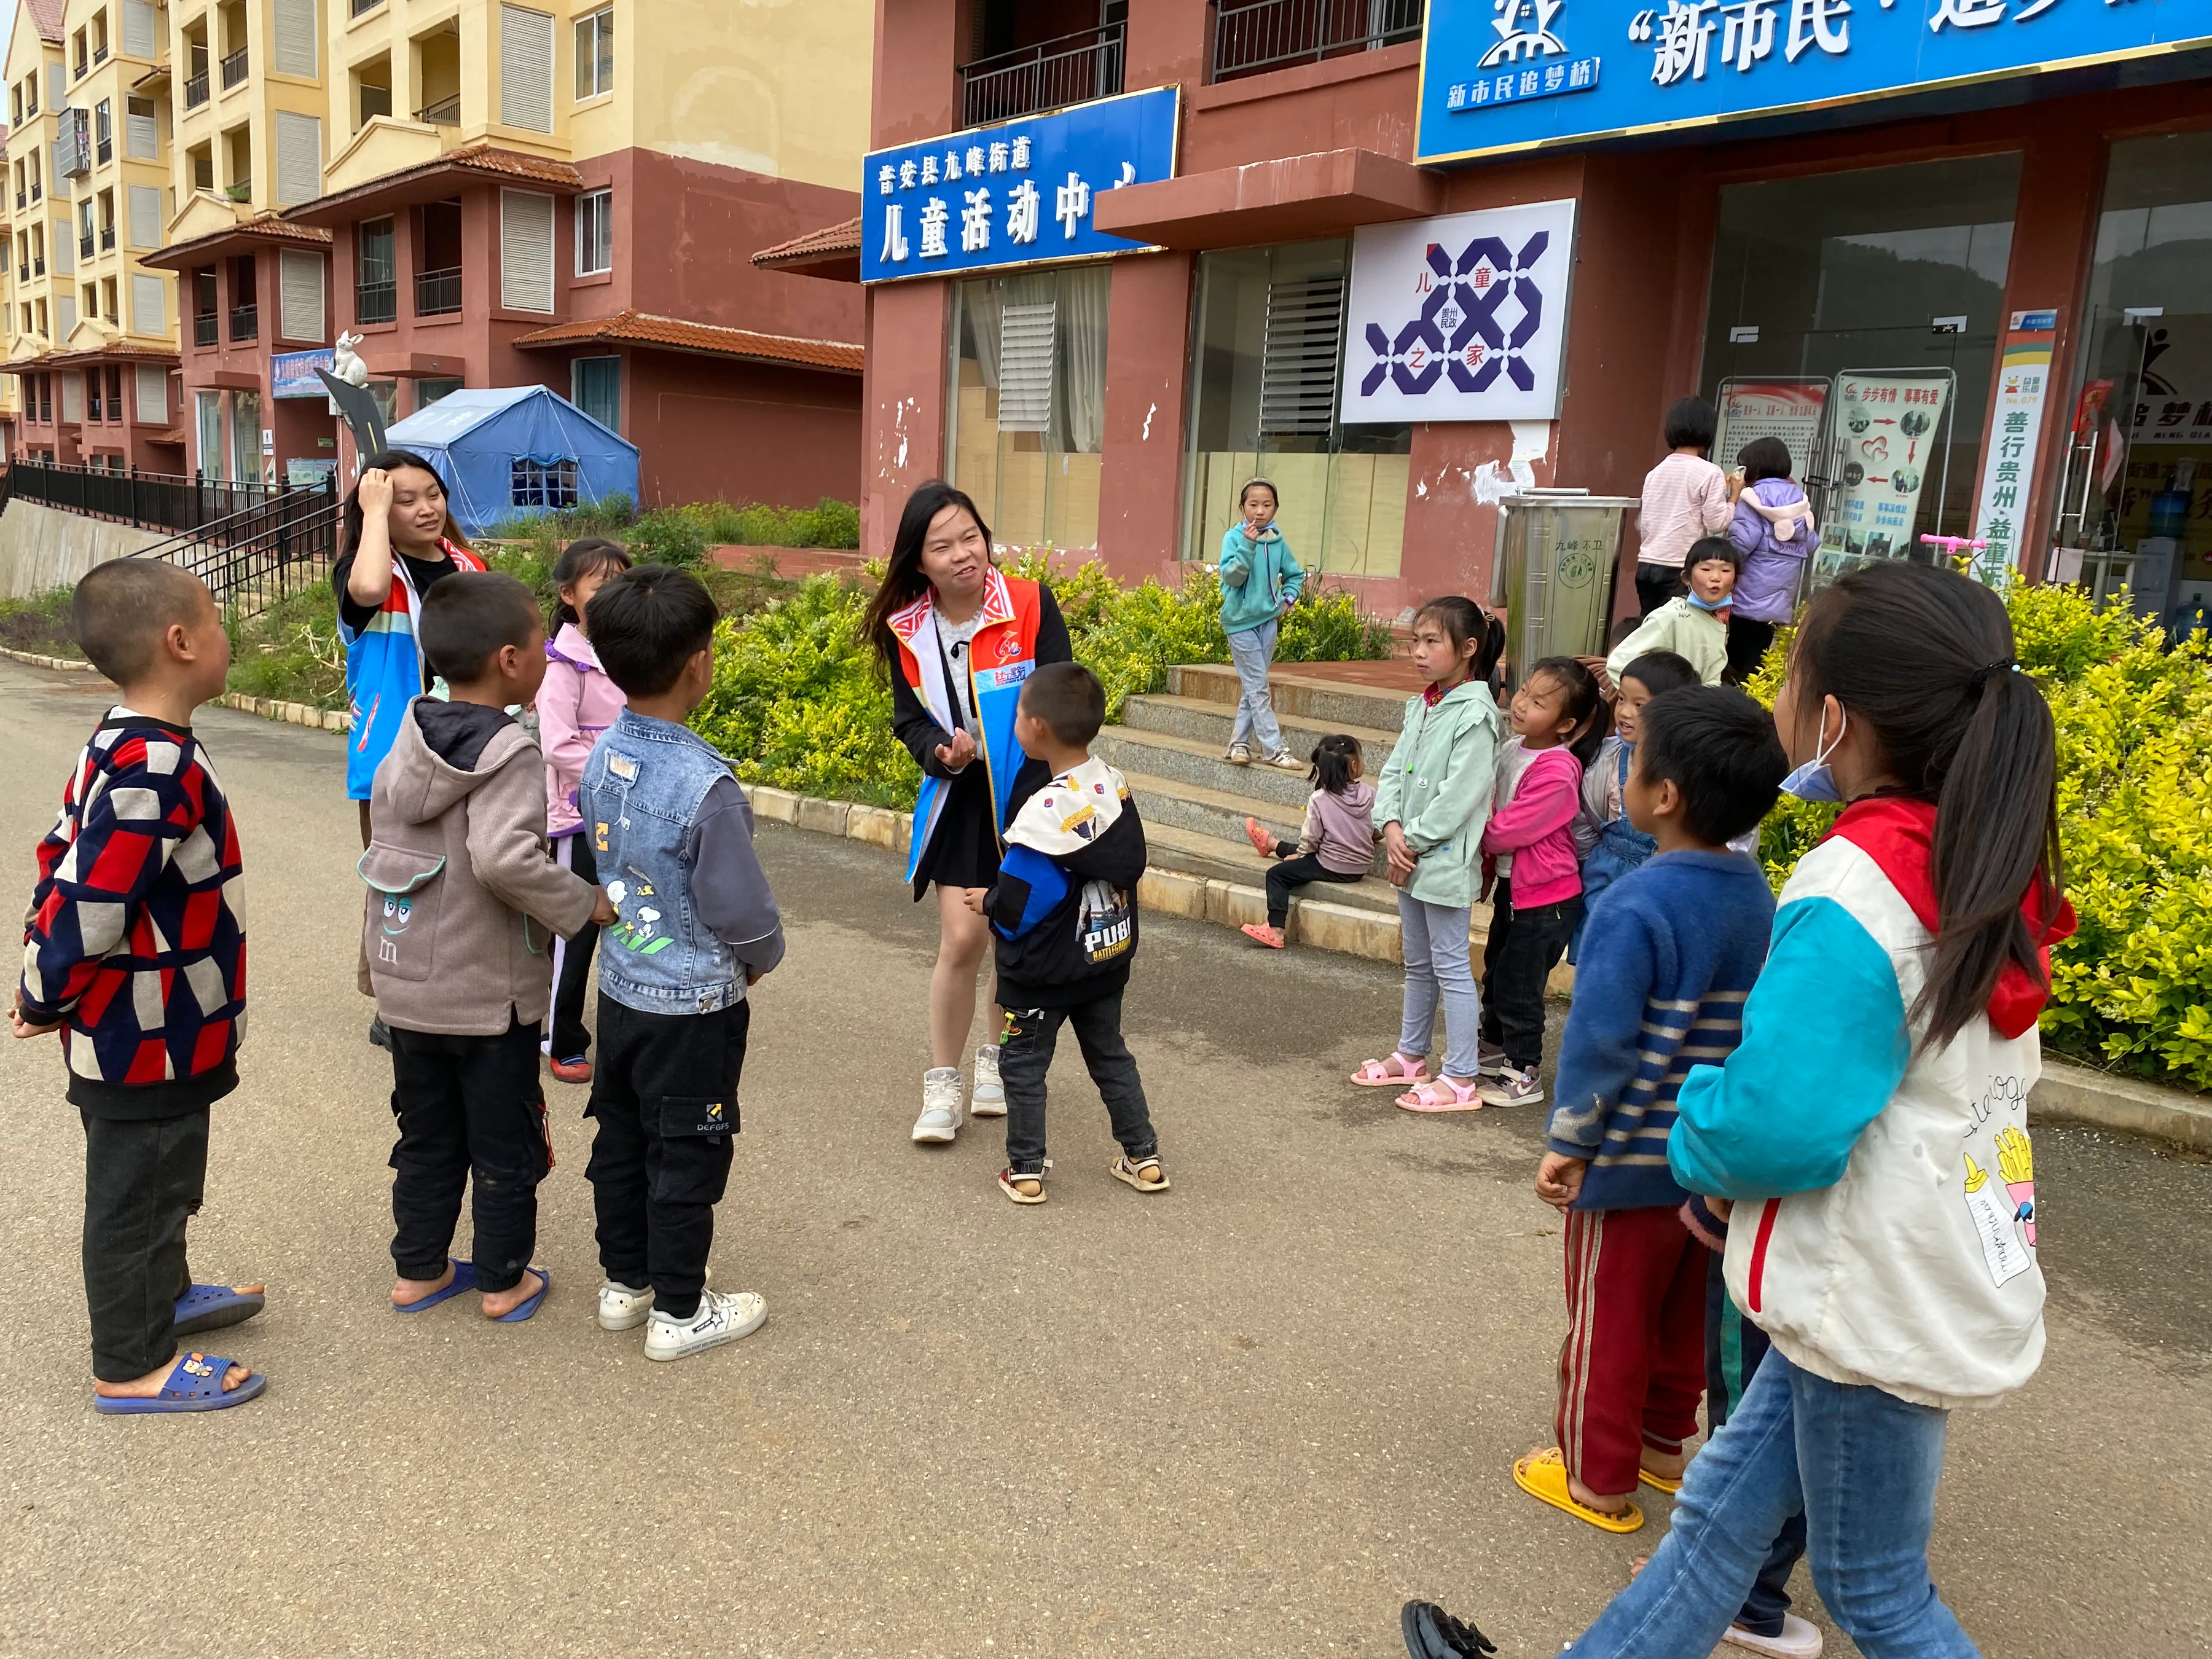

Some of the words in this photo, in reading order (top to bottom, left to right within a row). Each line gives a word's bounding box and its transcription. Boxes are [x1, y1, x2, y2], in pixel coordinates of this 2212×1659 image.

[1447, 58, 1593, 109] 新市民追梦桥
[879, 136, 1031, 195] 普安县九峰街道
[1441, 307, 1457, 318] 贵州
[1440, 318, 1457, 329] 民政
[1862, 386, 1897, 403] 步步有情
[1904, 388, 1939, 405] 事事有爱
[697, 1122, 729, 1131] DEFGFS
